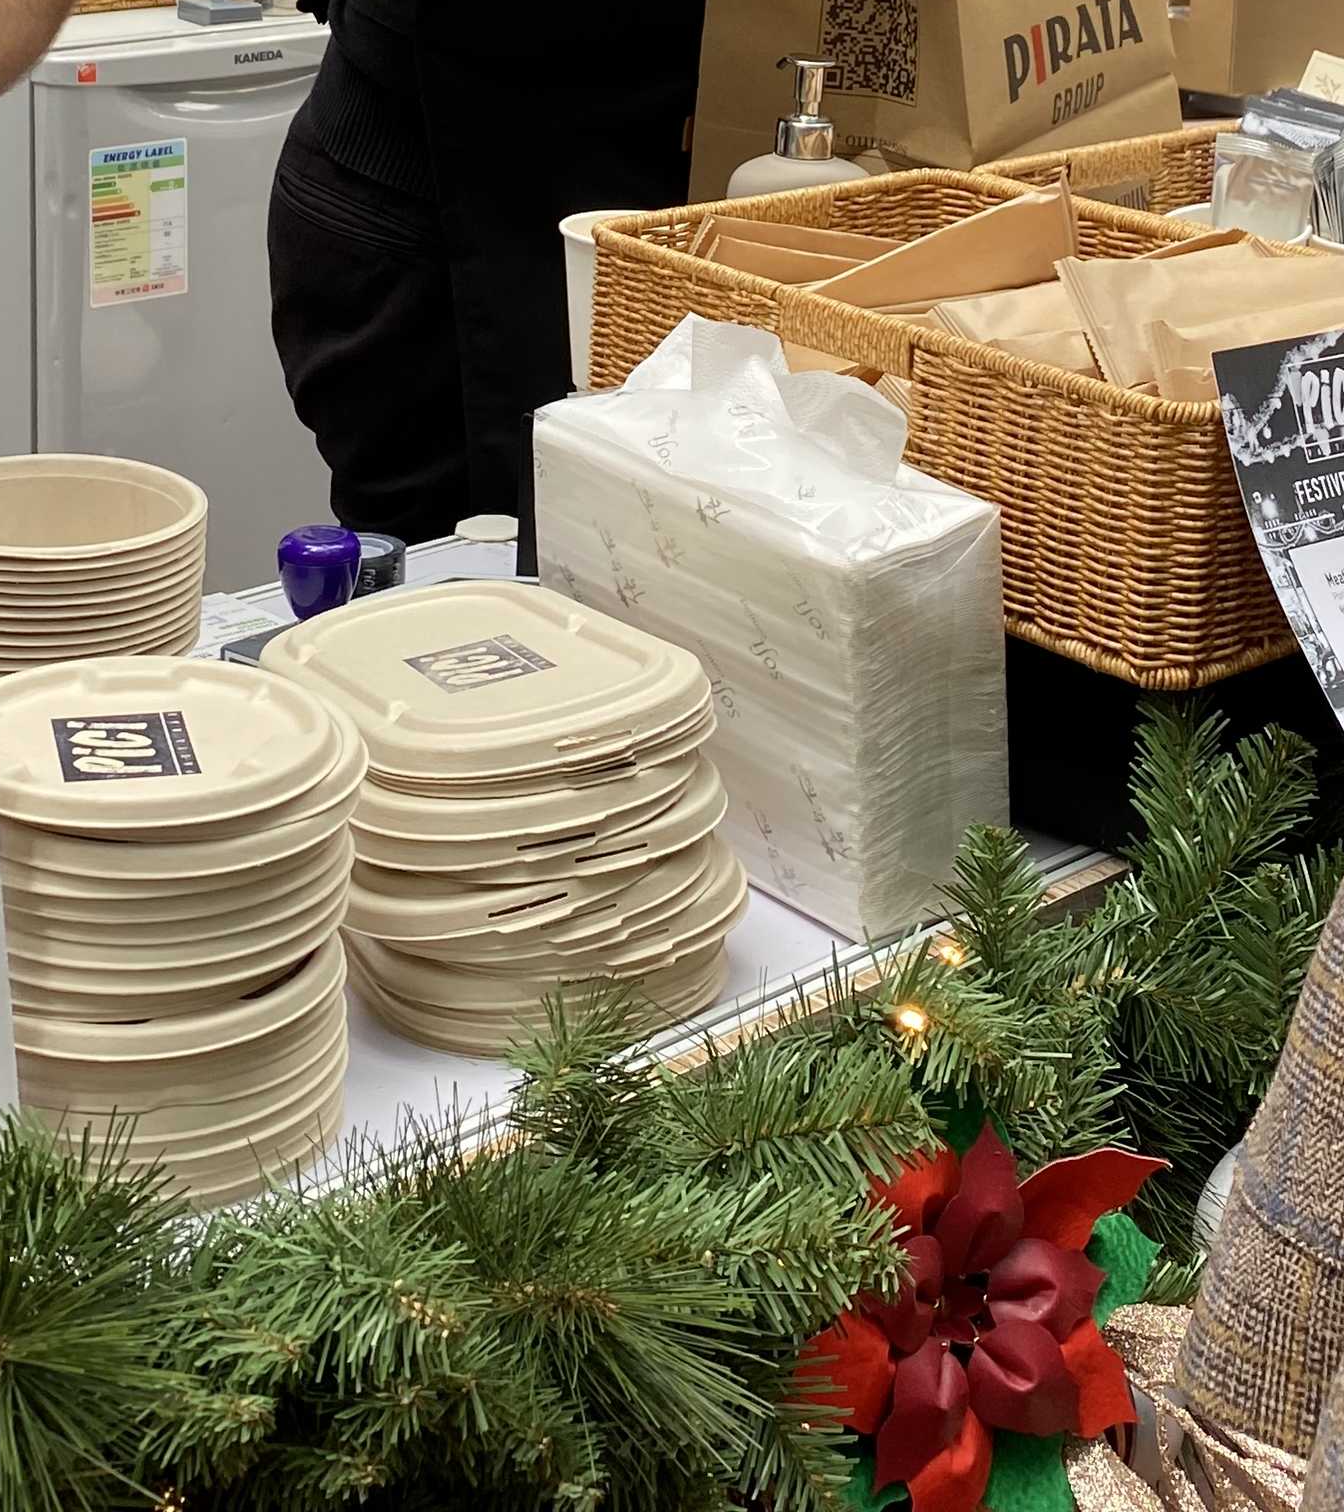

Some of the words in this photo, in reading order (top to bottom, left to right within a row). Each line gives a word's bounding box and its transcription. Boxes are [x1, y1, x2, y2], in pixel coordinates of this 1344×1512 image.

[234, 49, 284, 65] KANEDA
[1051, 71, 1105, 126] GROUP
[103, 149, 143, 164] ENERGY
[145, 145, 174, 159] LABEL
[747, 638, 784, 682] soft
